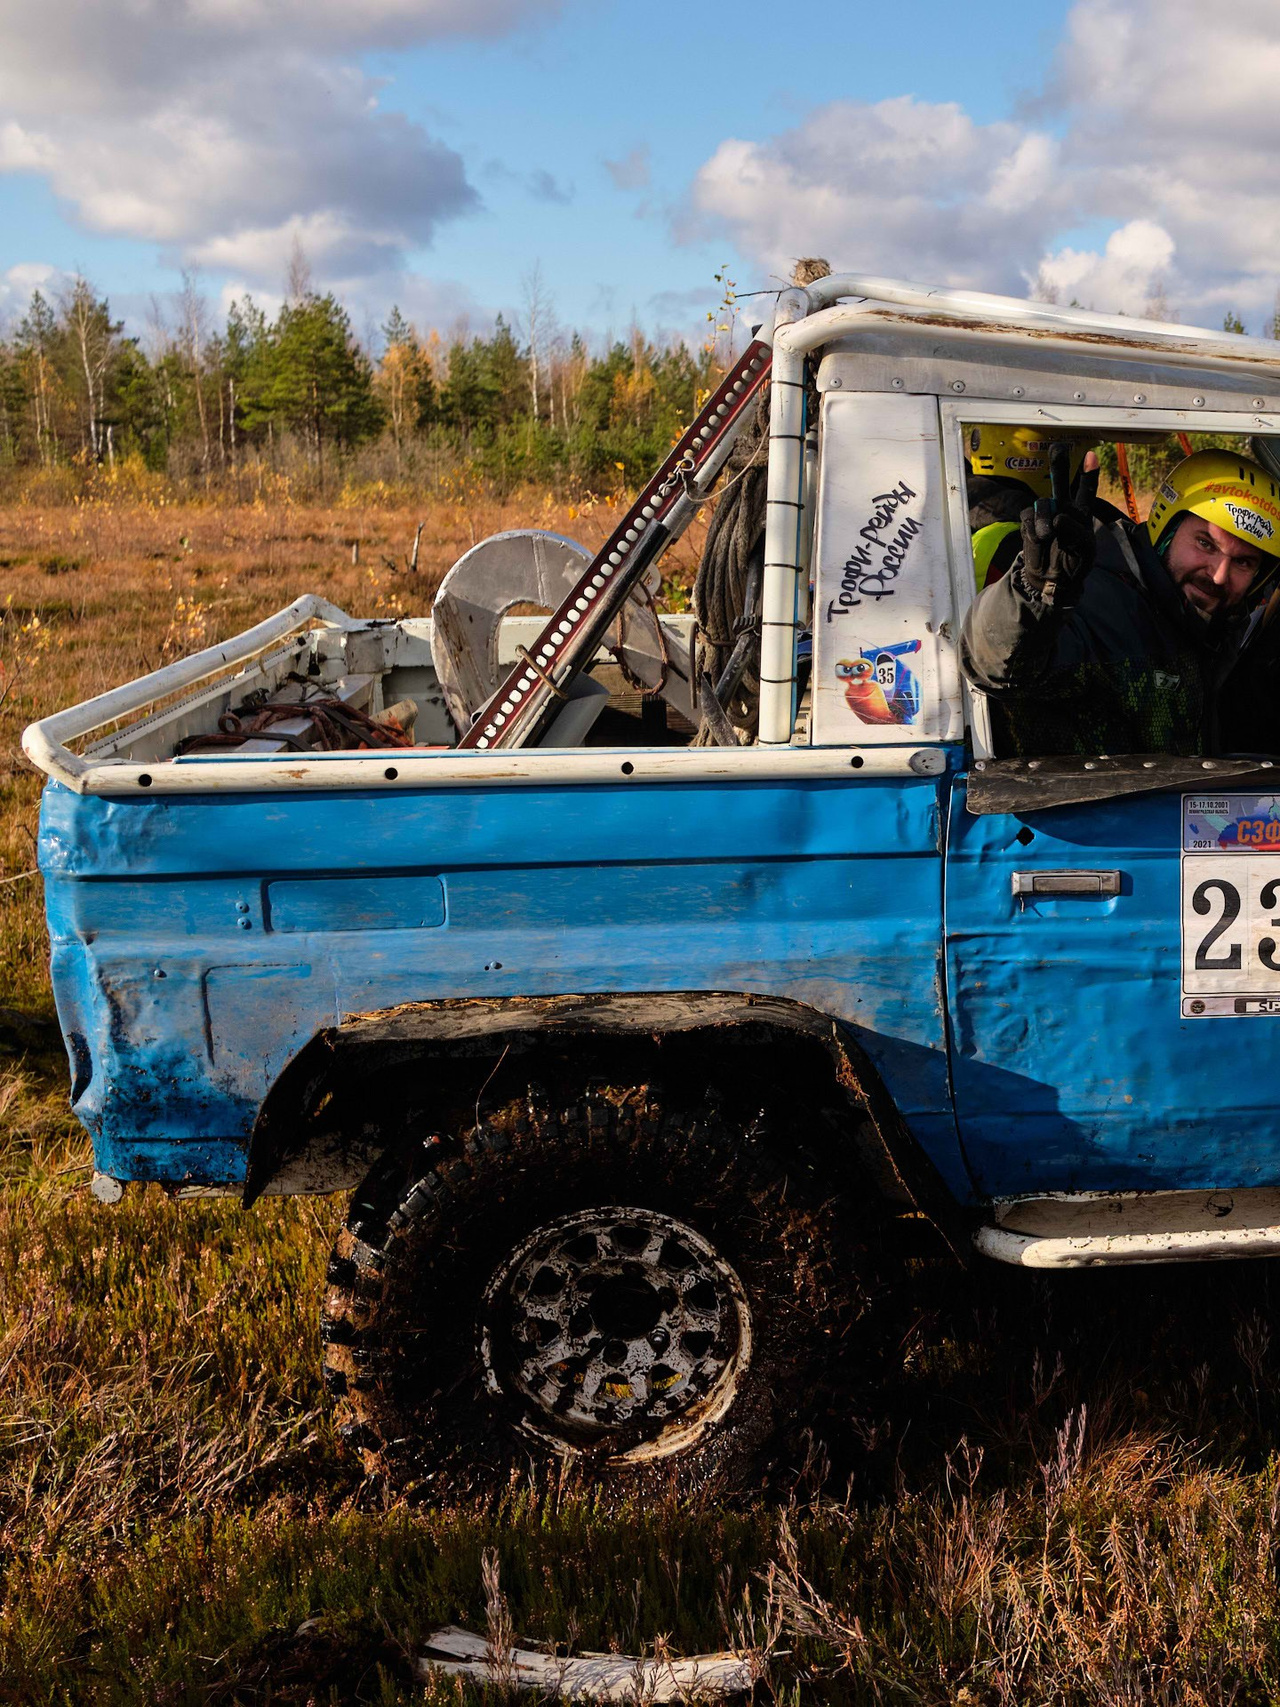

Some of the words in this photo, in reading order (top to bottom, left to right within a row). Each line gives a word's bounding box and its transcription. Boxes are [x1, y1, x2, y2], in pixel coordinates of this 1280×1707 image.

[827, 481, 916, 623] Трофи-рейды
[858, 517, 923, 601] России
[878, 667, 895, 685] 35
[1189, 801, 1229, 809] 15-17.10.2001
[1193, 840, 1212, 848] 2021
